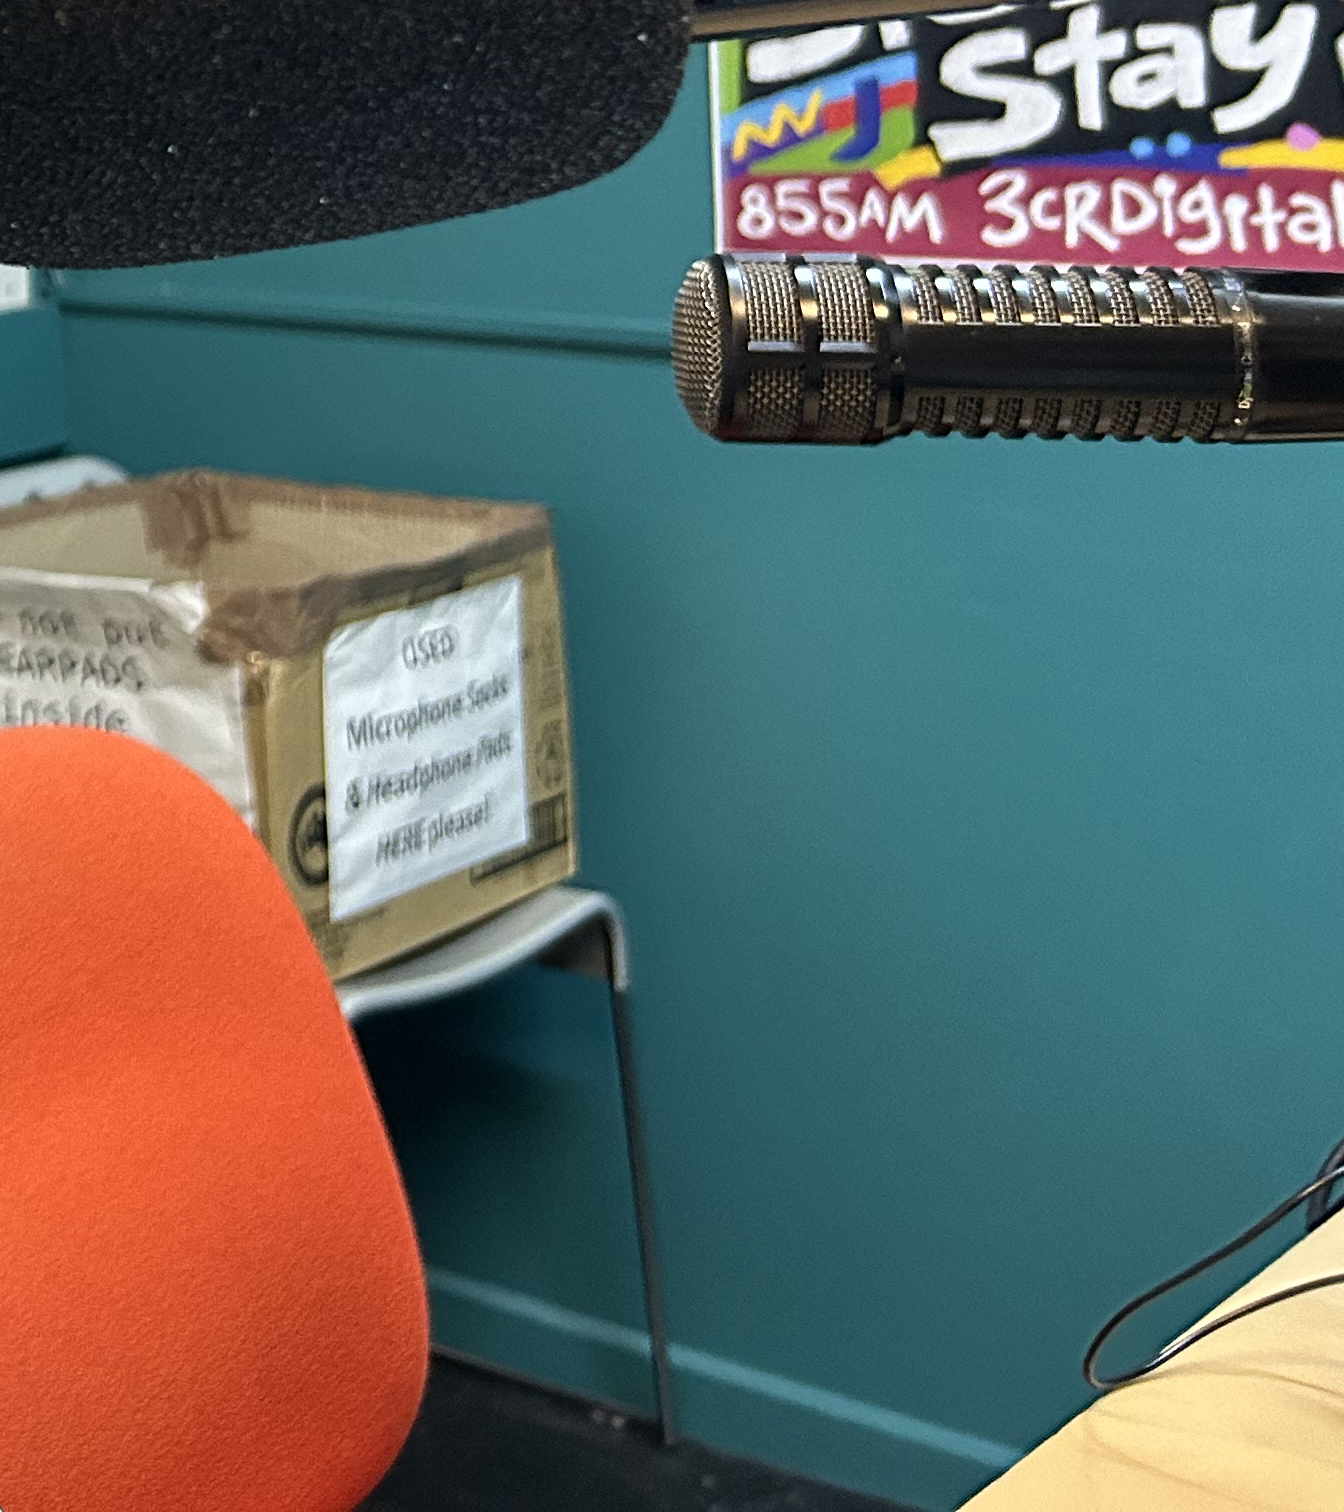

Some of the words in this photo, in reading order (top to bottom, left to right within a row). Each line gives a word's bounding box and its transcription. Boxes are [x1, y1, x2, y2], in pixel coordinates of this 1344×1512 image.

[928, 2, 1317, 162] Stay
[737, 178, 943, 245] 855AM
[402, 624, 459, 671] USED
[346, 691, 462, 752] Microphone
[367, 747, 473, 807] Headphone
